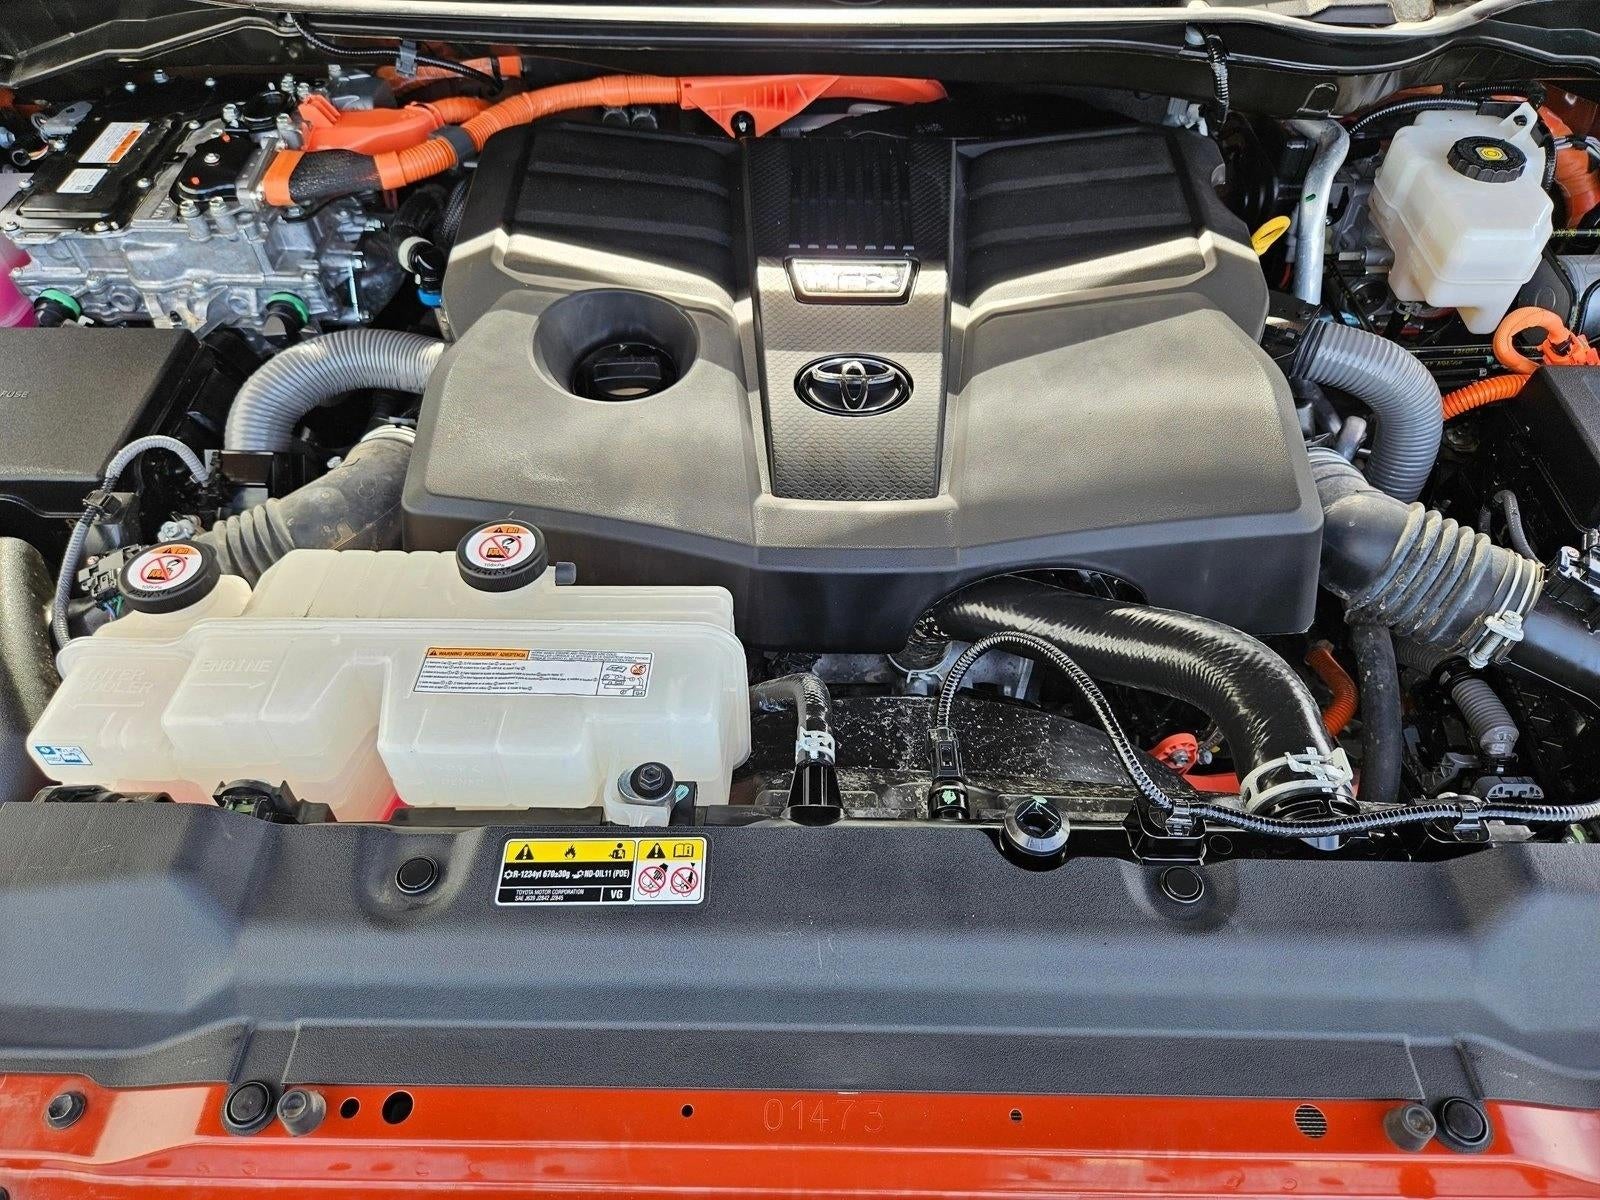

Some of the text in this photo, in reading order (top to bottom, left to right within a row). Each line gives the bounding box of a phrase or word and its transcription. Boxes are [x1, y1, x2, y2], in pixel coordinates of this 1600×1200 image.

[584, 869, 612, 878] ND-OIL11
[613, 869, 630, 878] (POE)
[610, 889, 623, 898] VG
[764, 1098, 884, 1132] 01473
